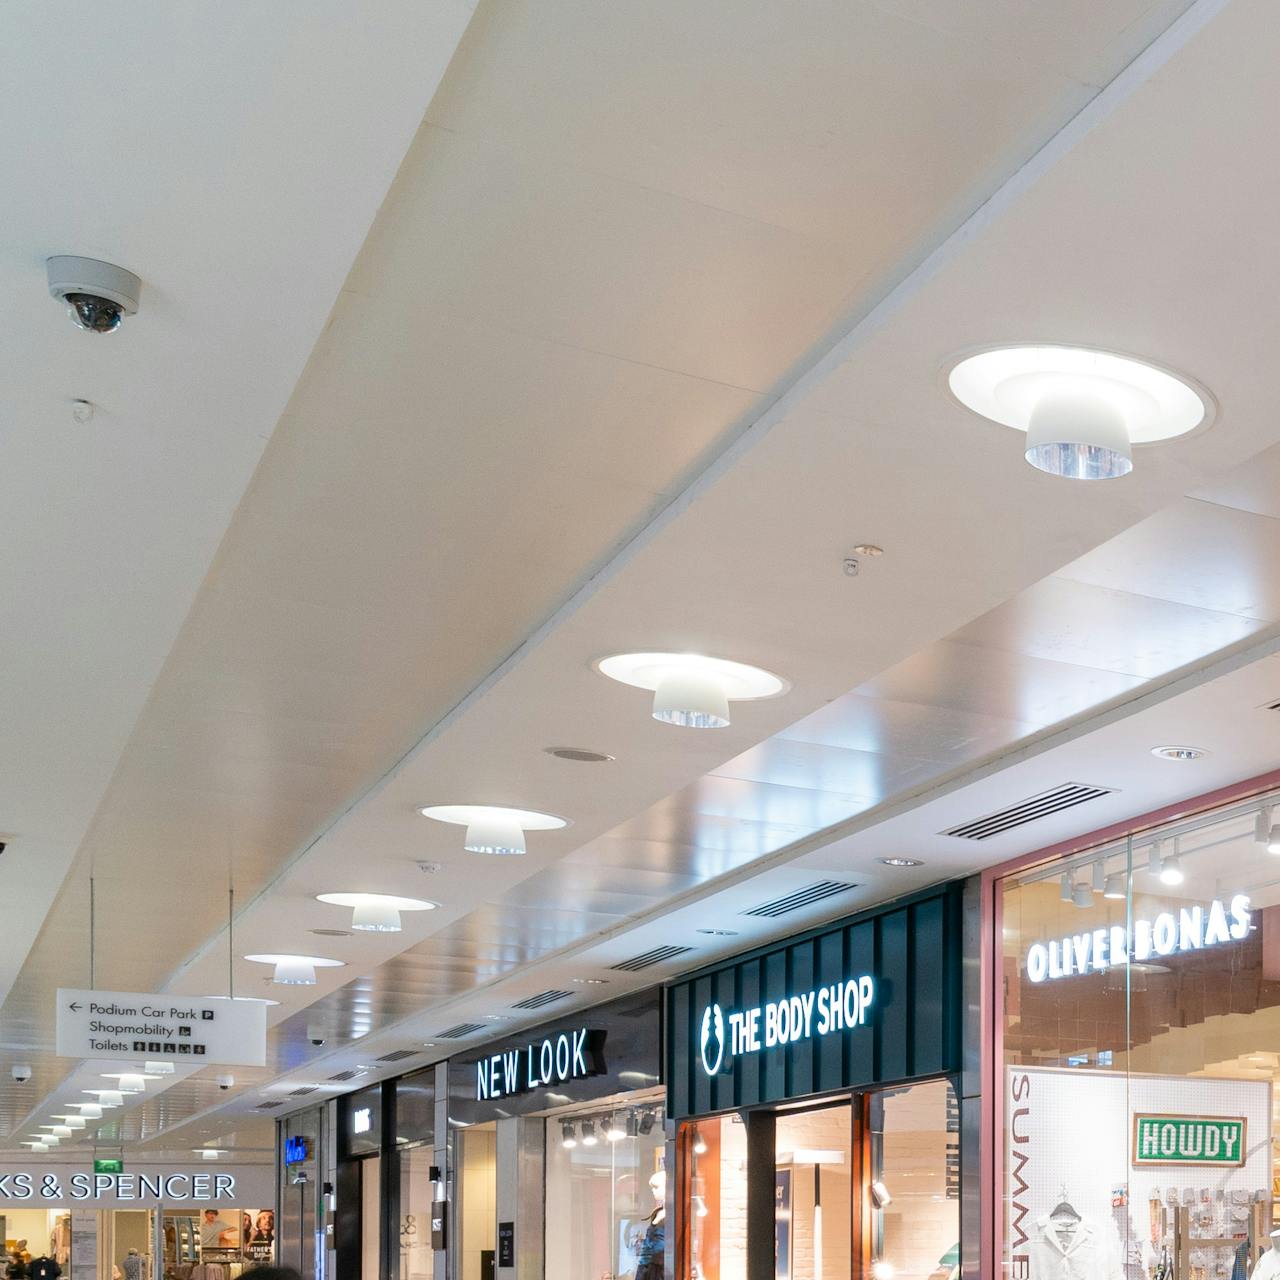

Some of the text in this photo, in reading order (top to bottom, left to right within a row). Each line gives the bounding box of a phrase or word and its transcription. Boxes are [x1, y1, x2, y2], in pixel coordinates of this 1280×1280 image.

[1027, 894, 1252, 983] OLIVER BONAS
[90, 1003, 136, 1016] Podium
[141, 1006, 165, 1018] Car
[170, 1008, 197, 1019] Park
[729, 975, 873, 1055] THE BODY SHOP
[90, 1021, 174, 1038] Shopmobility
[89, 1039, 128, 1051] Toilets
[477, 1028, 586, 1101] NEW LOOK
[1142, 1123, 1238, 1157] HOWDY
[40, 1173, 63, 1199] &
[70, 1173, 236, 1199] SPENCER
